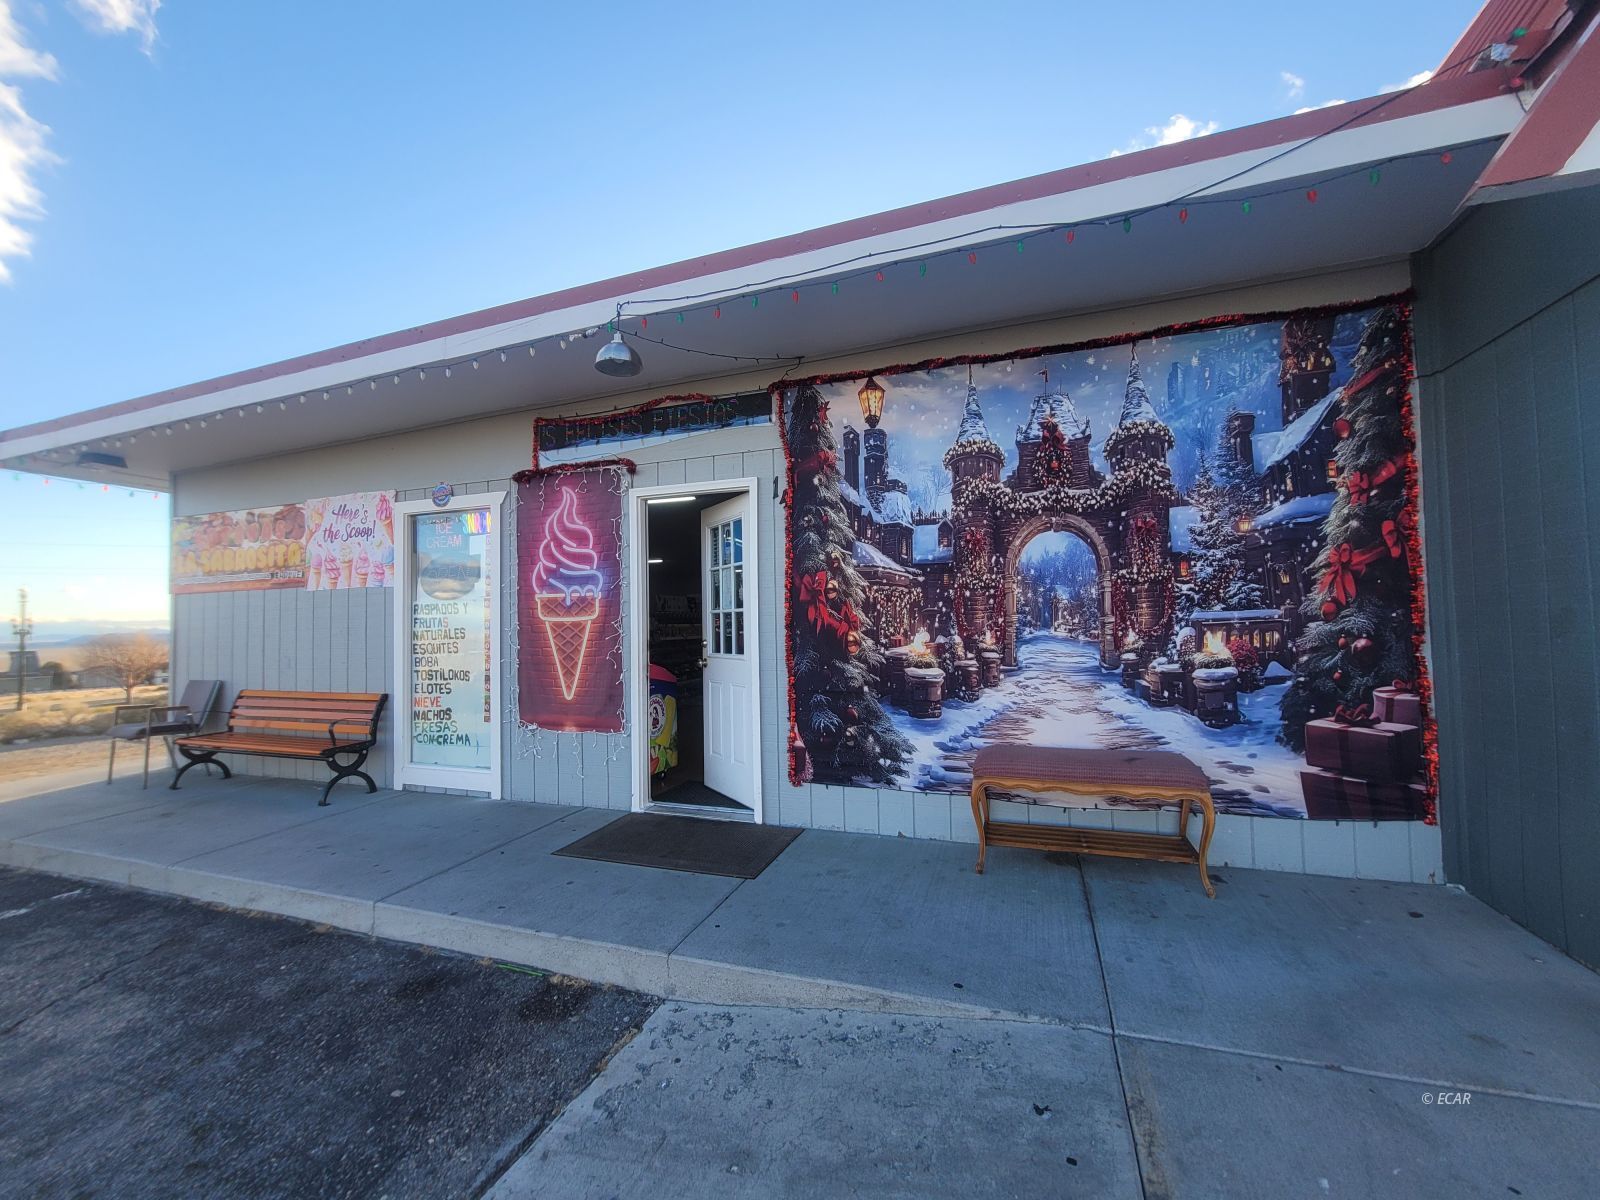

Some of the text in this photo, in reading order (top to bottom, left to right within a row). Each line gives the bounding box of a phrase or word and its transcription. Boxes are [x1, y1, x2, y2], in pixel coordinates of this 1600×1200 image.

[332, 503, 369, 524] Here's
[323, 519, 376, 543] the Scoop!
[413, 603, 468, 616] RASPADOS Y
[413, 617, 449, 629] FRUTAS
[412, 628, 466, 641] NATURALES
[414, 656, 439, 668] BOBA
[414, 682, 452, 695] ELOTES
[413, 707, 453, 721] NACHOS
[414, 720, 458, 734] FRESAS
